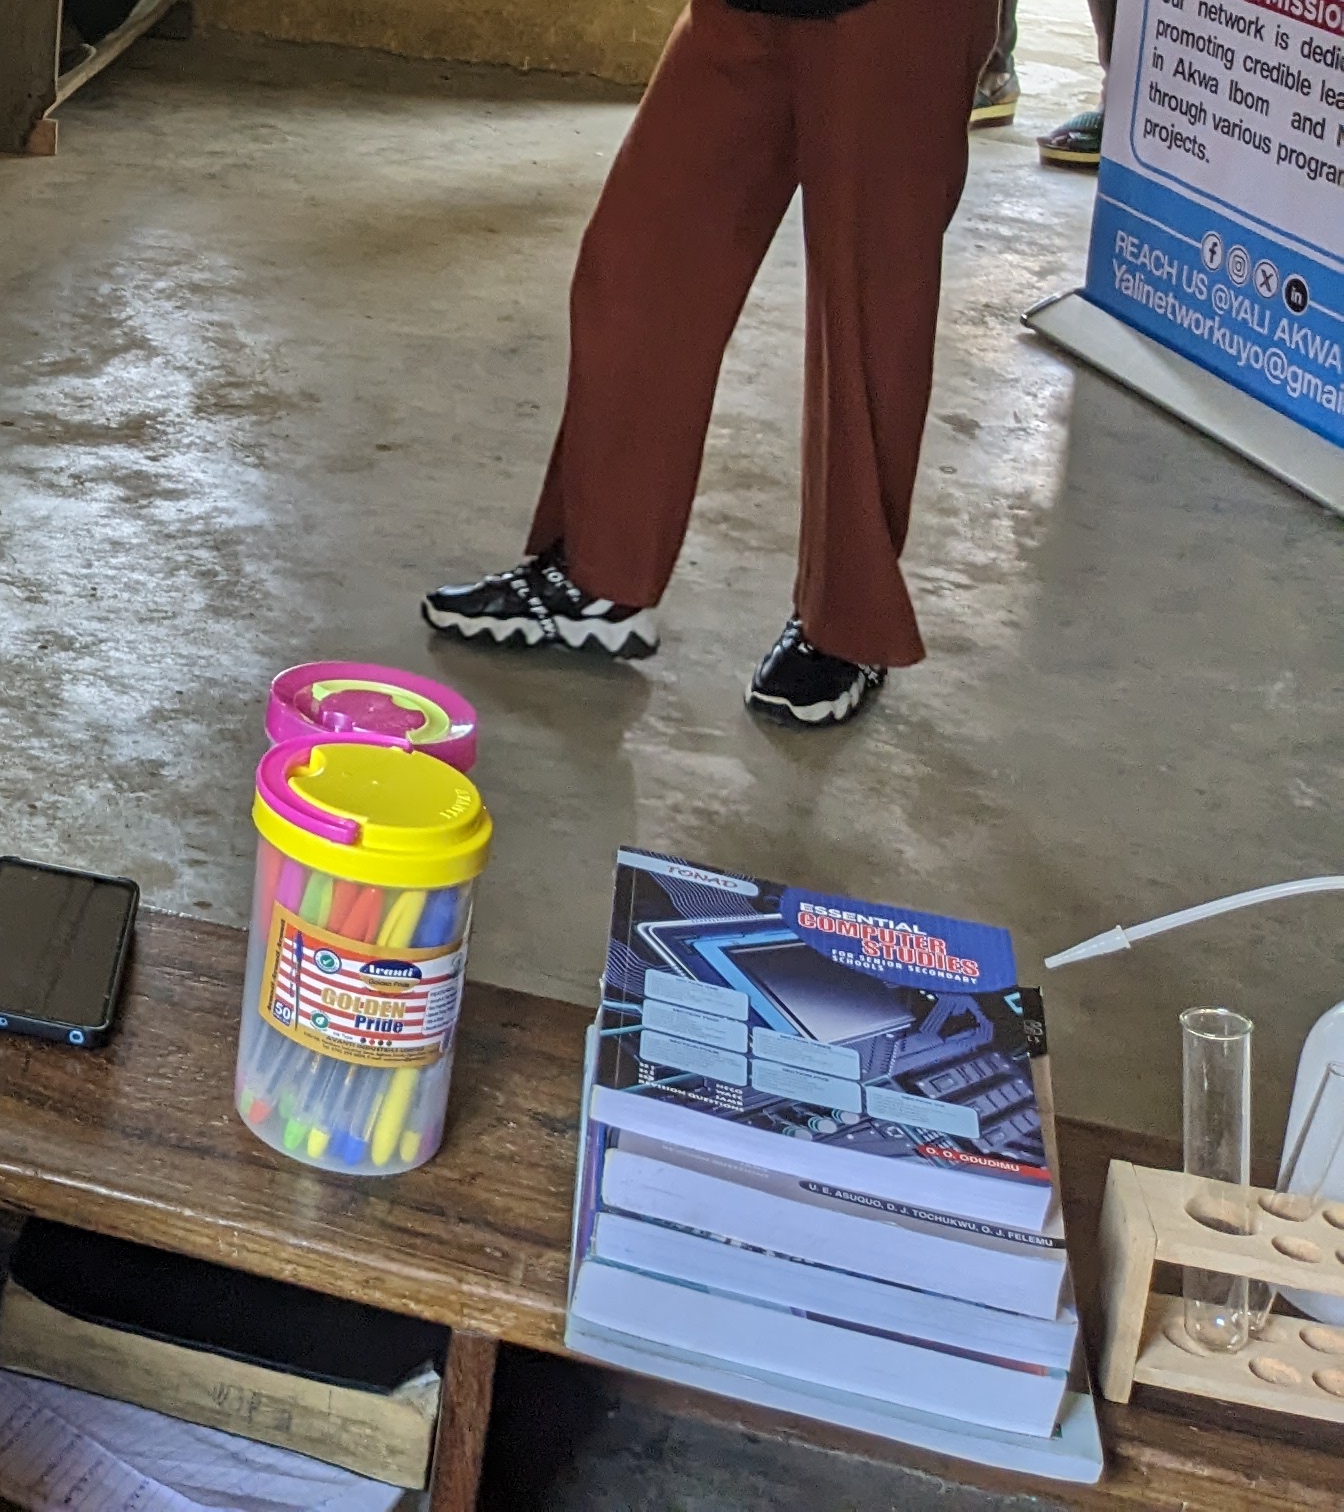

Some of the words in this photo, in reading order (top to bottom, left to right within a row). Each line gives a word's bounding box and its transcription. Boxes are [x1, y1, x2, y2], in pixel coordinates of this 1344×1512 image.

[1198, 0, 1266, 41] network
[1274, 24, 1289, 50] is
[1156, 18, 1235, 70] promoting
[1243, 54, 1312, 96] credible
[1152, 46, 1164, 71] in
[1173, 58, 1219, 95] Akwa
[1229, 79, 1269, 116] Ibom
[1291, 111, 1326, 140] and
[1149, 81, 1207, 126] through
[1212, 113, 1272, 154] various
[1143, 117, 1210, 163] projects.
[1115, 229, 1178, 285] REACH
[1182, 270, 1208, 301] US
[1212, 283, 1270, 335] @YALI
[1273, 317, 1342, 375] AKWA
[667, 865, 738, 888] TONAD
[798, 912, 947, 955] COMPUTER
[800, 902, 927, 935] ESSENTIAL
[832, 955, 885, 972] SCHOOLS
[832, 949, 853, 958] FOR
[859, 954, 902, 969] SENIOR
[908, 965, 978, 985] SECONDARY
[862, 940, 980, 977] STUDIES
[275, 1002, 291, 1018] 50
[321, 987, 406, 1019] GOLDEN
[354, 1015, 404, 1033] Pride
[926, 1147, 938, 1156] O.
[943, 1151, 956, 1160] O.
[809, 1183, 819, 1192] U.
[822, 1187, 832, 1196] E.
[887, 1203, 897, 1212] D.
[900, 1207, 910, 1215] J.
[981, 1225, 993, 1235] O.
[995, 1230, 1005, 1238] J.
[1008, 1232, 1053, 1247] FELEMU
